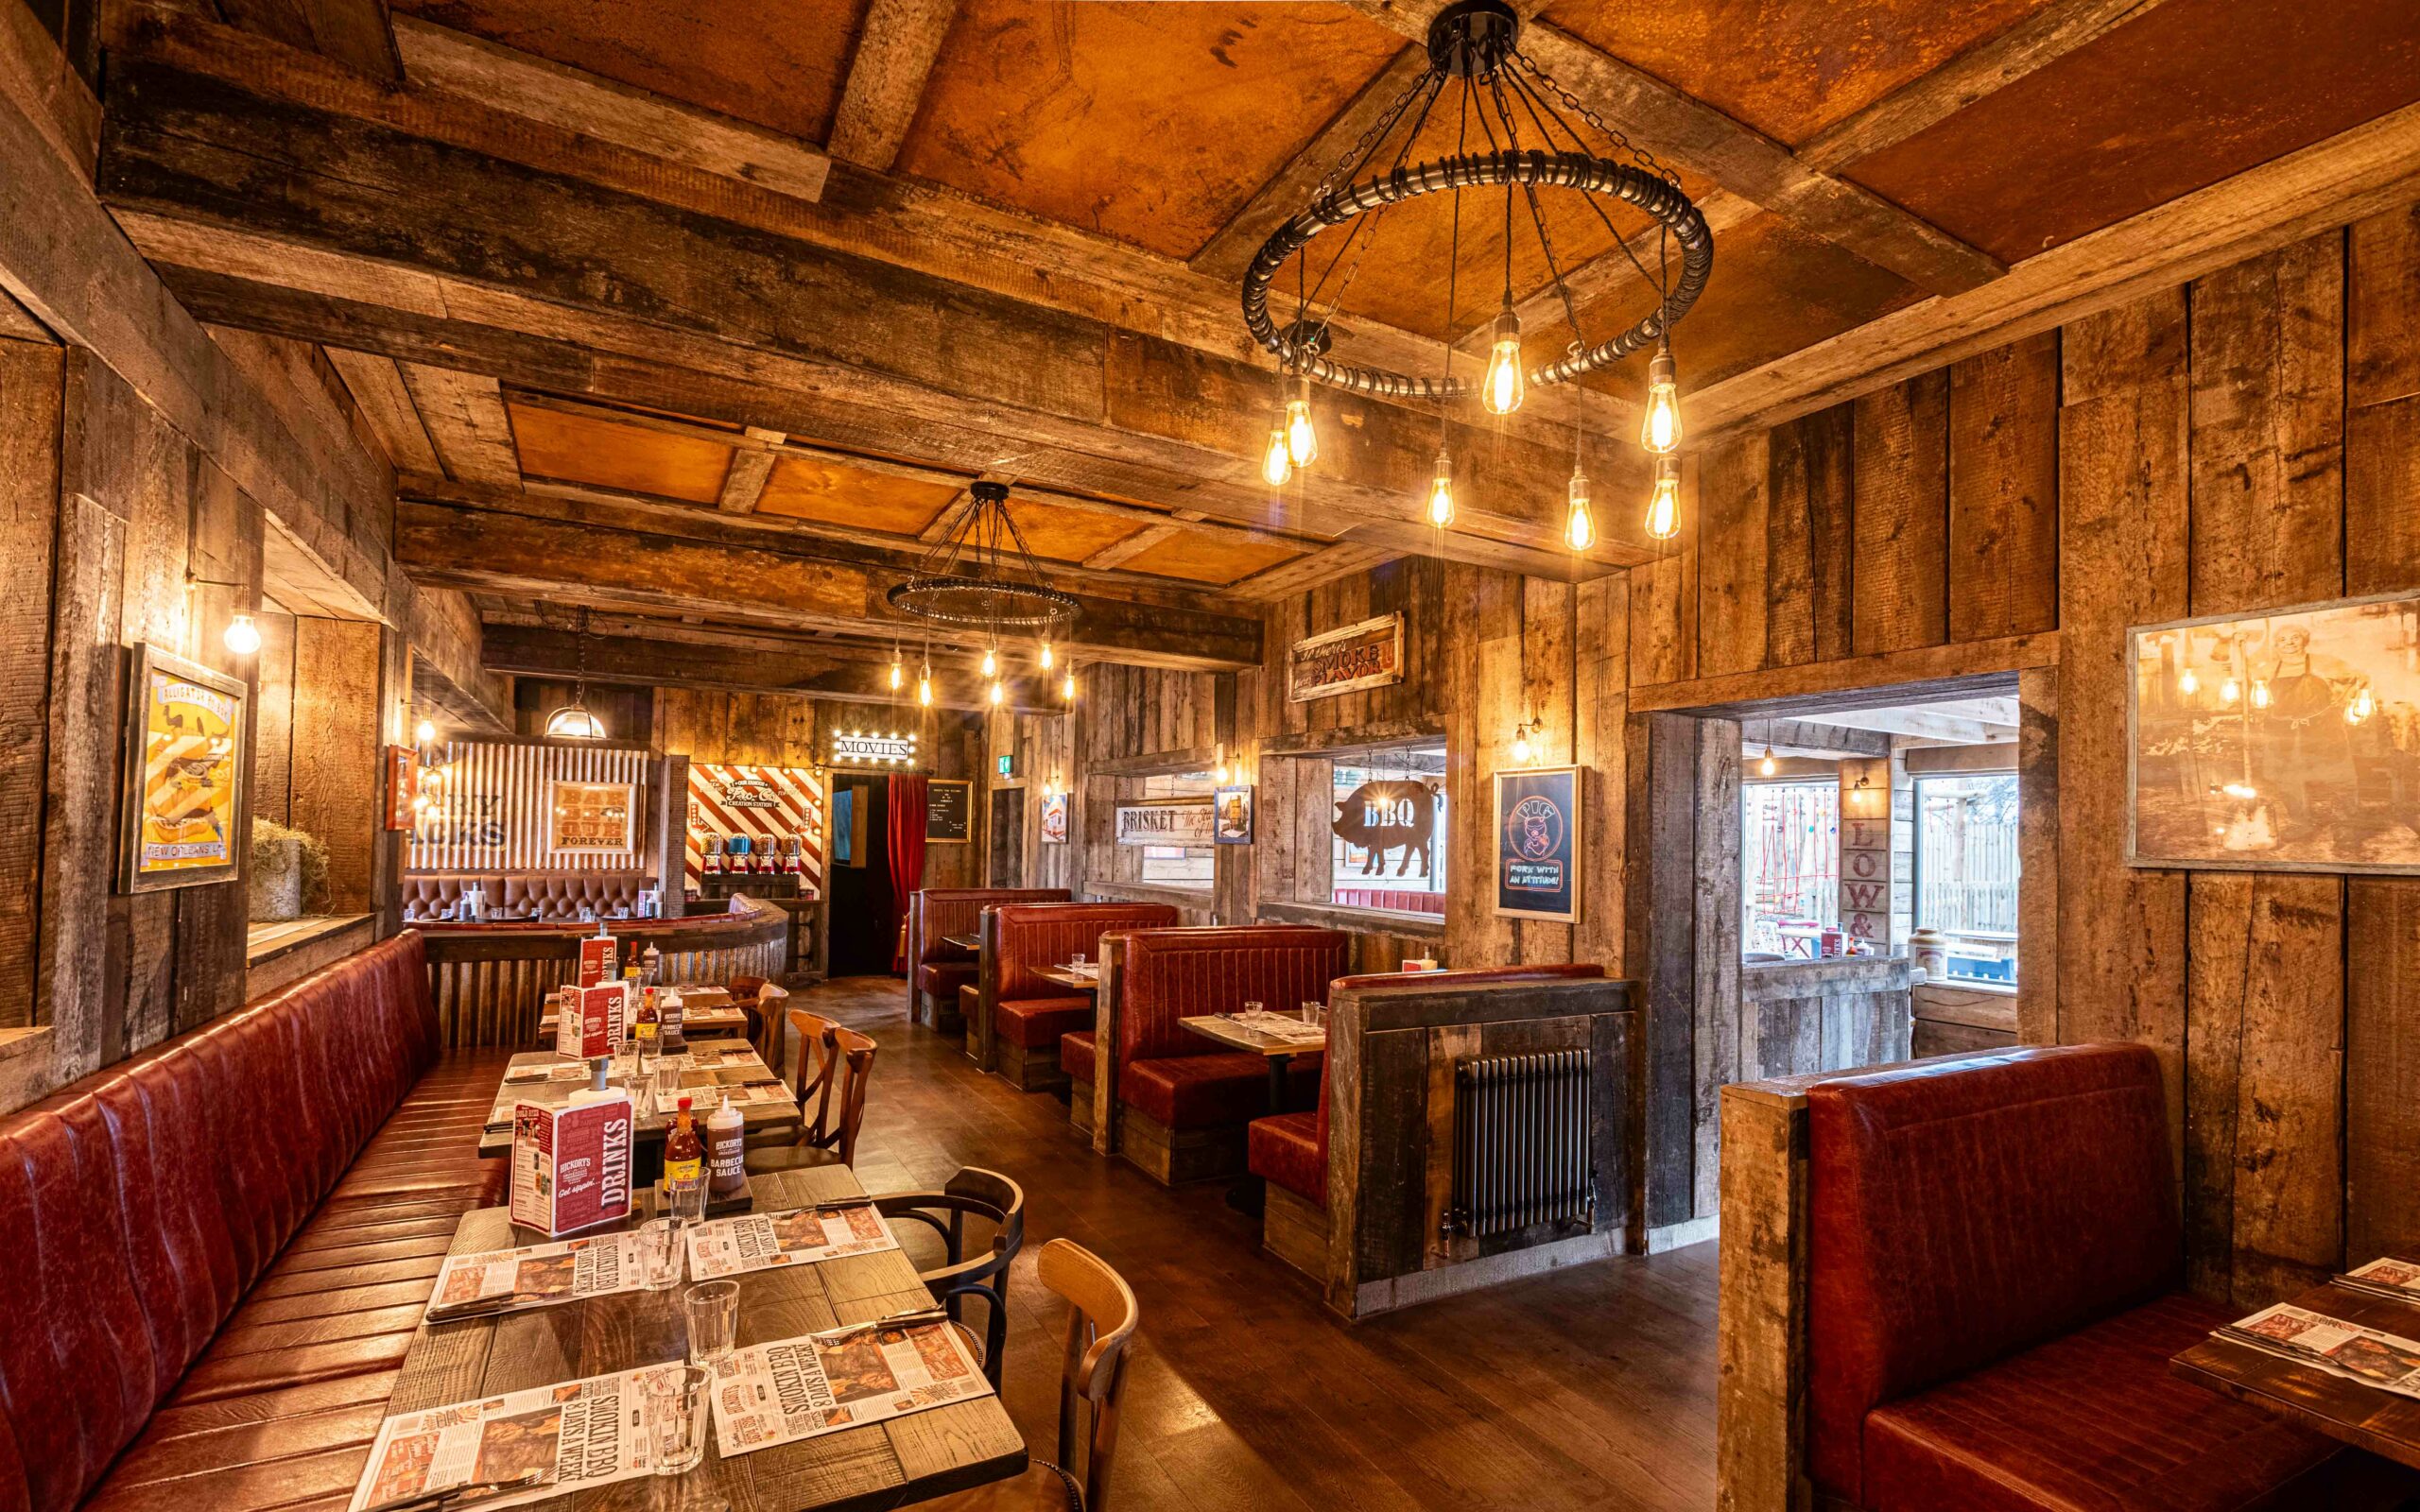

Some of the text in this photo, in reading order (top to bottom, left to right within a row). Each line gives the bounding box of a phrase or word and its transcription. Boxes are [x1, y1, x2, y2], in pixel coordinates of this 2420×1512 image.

[1312, 644, 1379, 674] SMOKE
[1312, 661, 1383, 687] FLAVOR
[839, 741, 908, 755] MOVIES
[562, 790, 627, 806] BAR
[562, 808, 600, 821] BE
[1363, 799, 1415, 827] BBQ
[1516, 800, 1556, 819] PIG
[562, 821, 622, 836] QUE
[1123, 810, 1175, 833] BRISKET
[562, 836, 624, 846] FOREVER
[147, 845, 169, 857] NEW
[1510, 865, 1559, 874] PORK WITH
[1510, 875, 1560, 885] AN ATTITUDE!
[607, 996, 622, 1047] DRINKS
[601, 1118, 628, 1209] DRINKS
[716, 1164, 740, 1177] SAUCE
[558, 1187, 571, 1198] Get
[767, 1346, 810, 1415] SMOKIN BBQ
[805, 1378, 831, 1401] DAYS
[565, 1401, 587, 1410] 8
[563, 1409, 587, 1436] DAYS
[810, 1410, 825, 1429] STATES
[586, 1395, 620, 1479] SMOKIN BBQ
